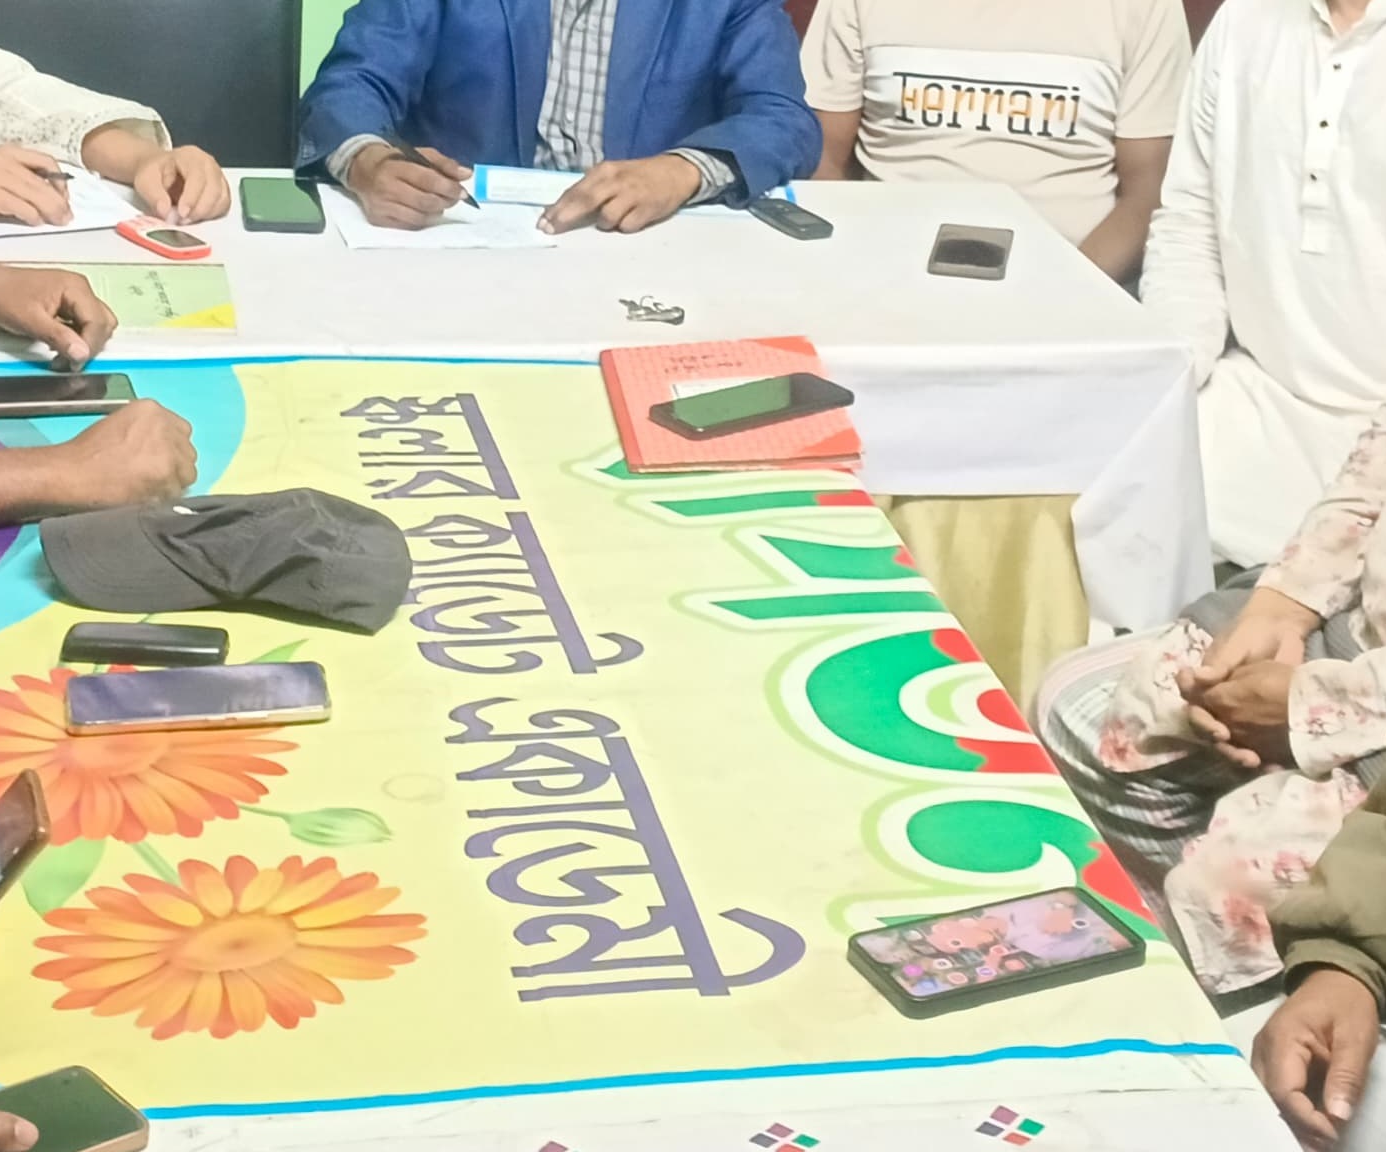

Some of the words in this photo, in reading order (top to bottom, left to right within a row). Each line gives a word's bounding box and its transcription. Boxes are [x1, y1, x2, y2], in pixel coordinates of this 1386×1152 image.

[339, 392, 520, 501] স্কলার
[402, 510, 645, 676] ক্যাডেট
[444, 696, 806, 1003] একাডেমী
